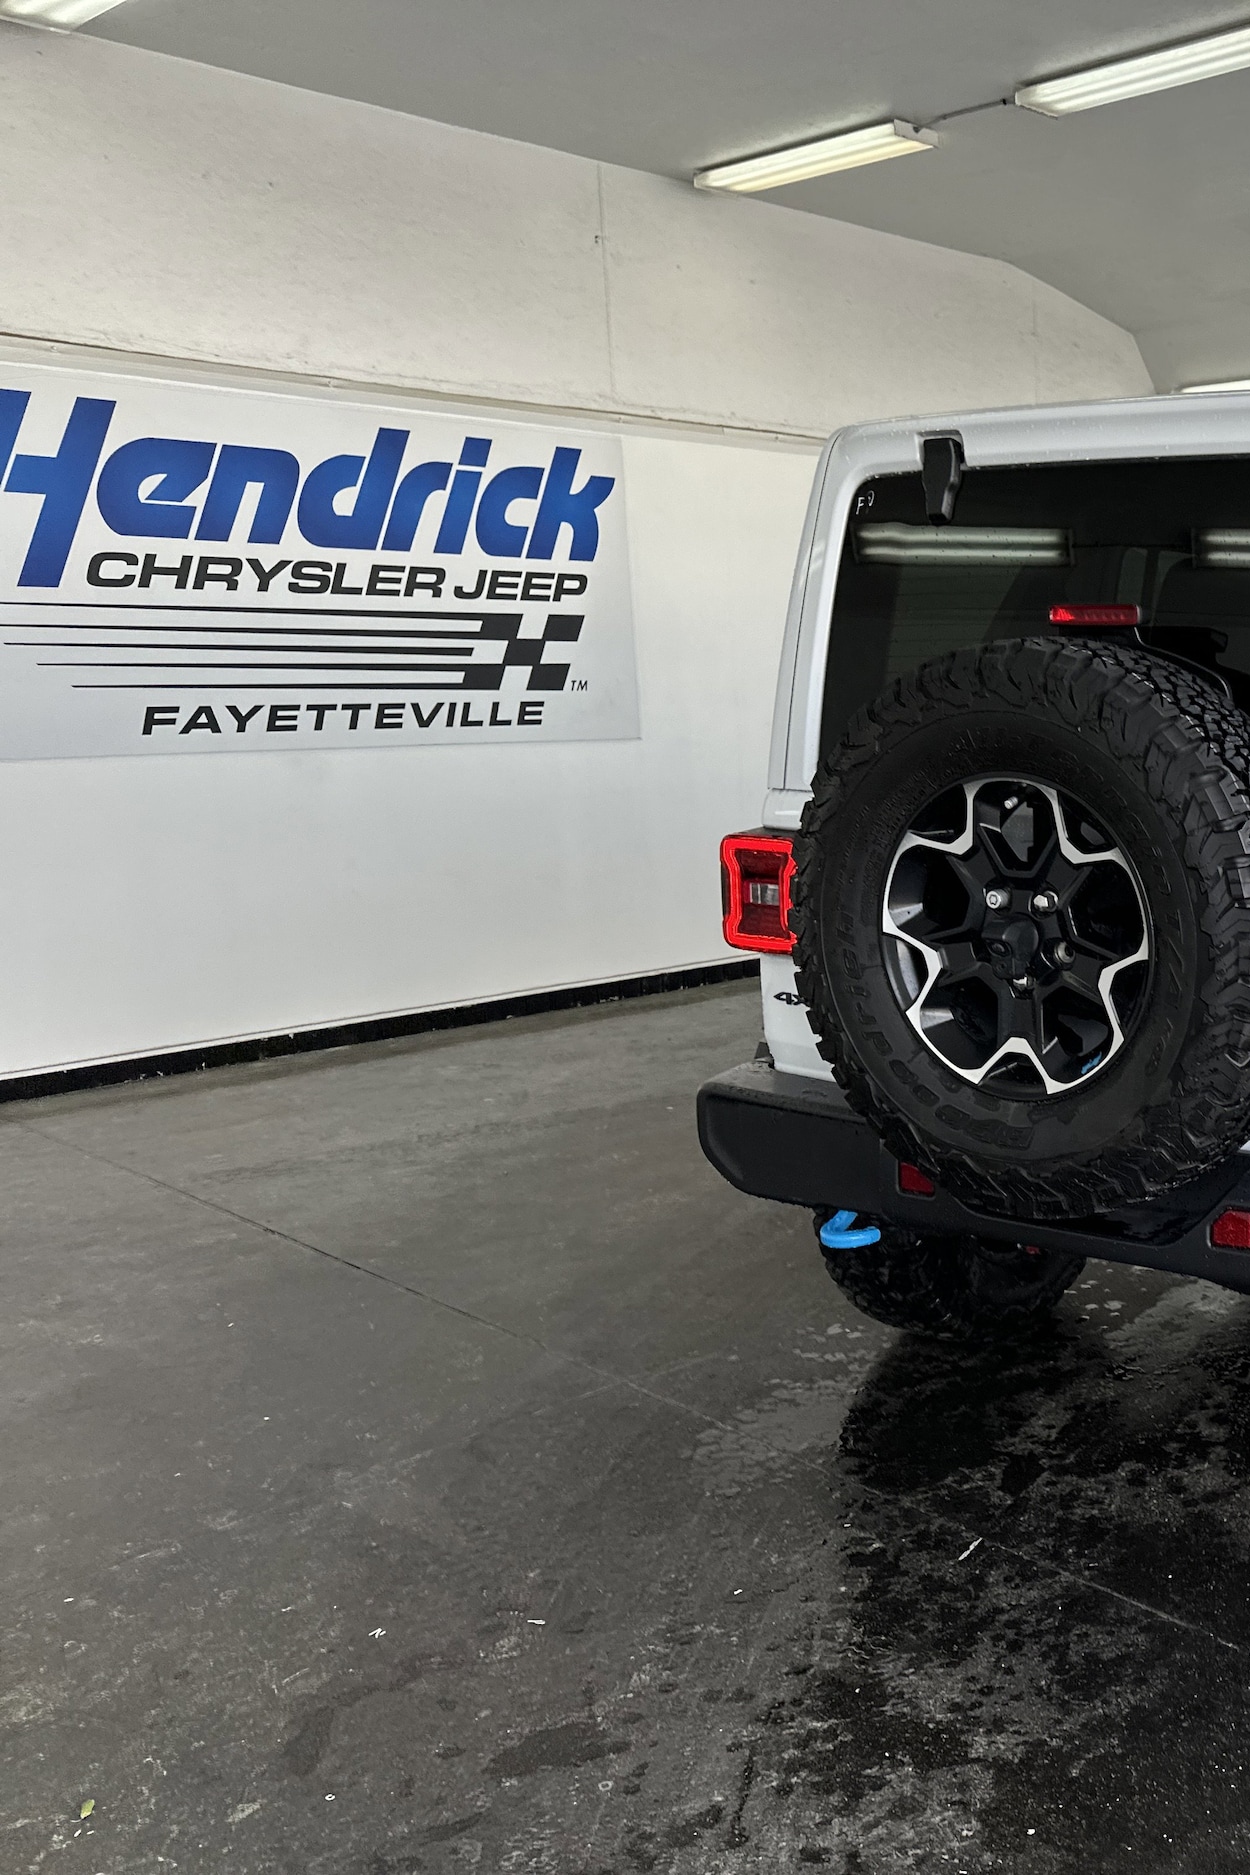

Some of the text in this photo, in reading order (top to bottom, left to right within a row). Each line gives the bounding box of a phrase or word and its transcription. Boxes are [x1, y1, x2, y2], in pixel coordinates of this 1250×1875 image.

[0, 388, 615, 588] Hendrick
[87, 552, 588, 602] CHRYSLER JEEP
[571, 680, 588, 692] TM
[142, 701, 545, 735] FAYETTEVILLE
